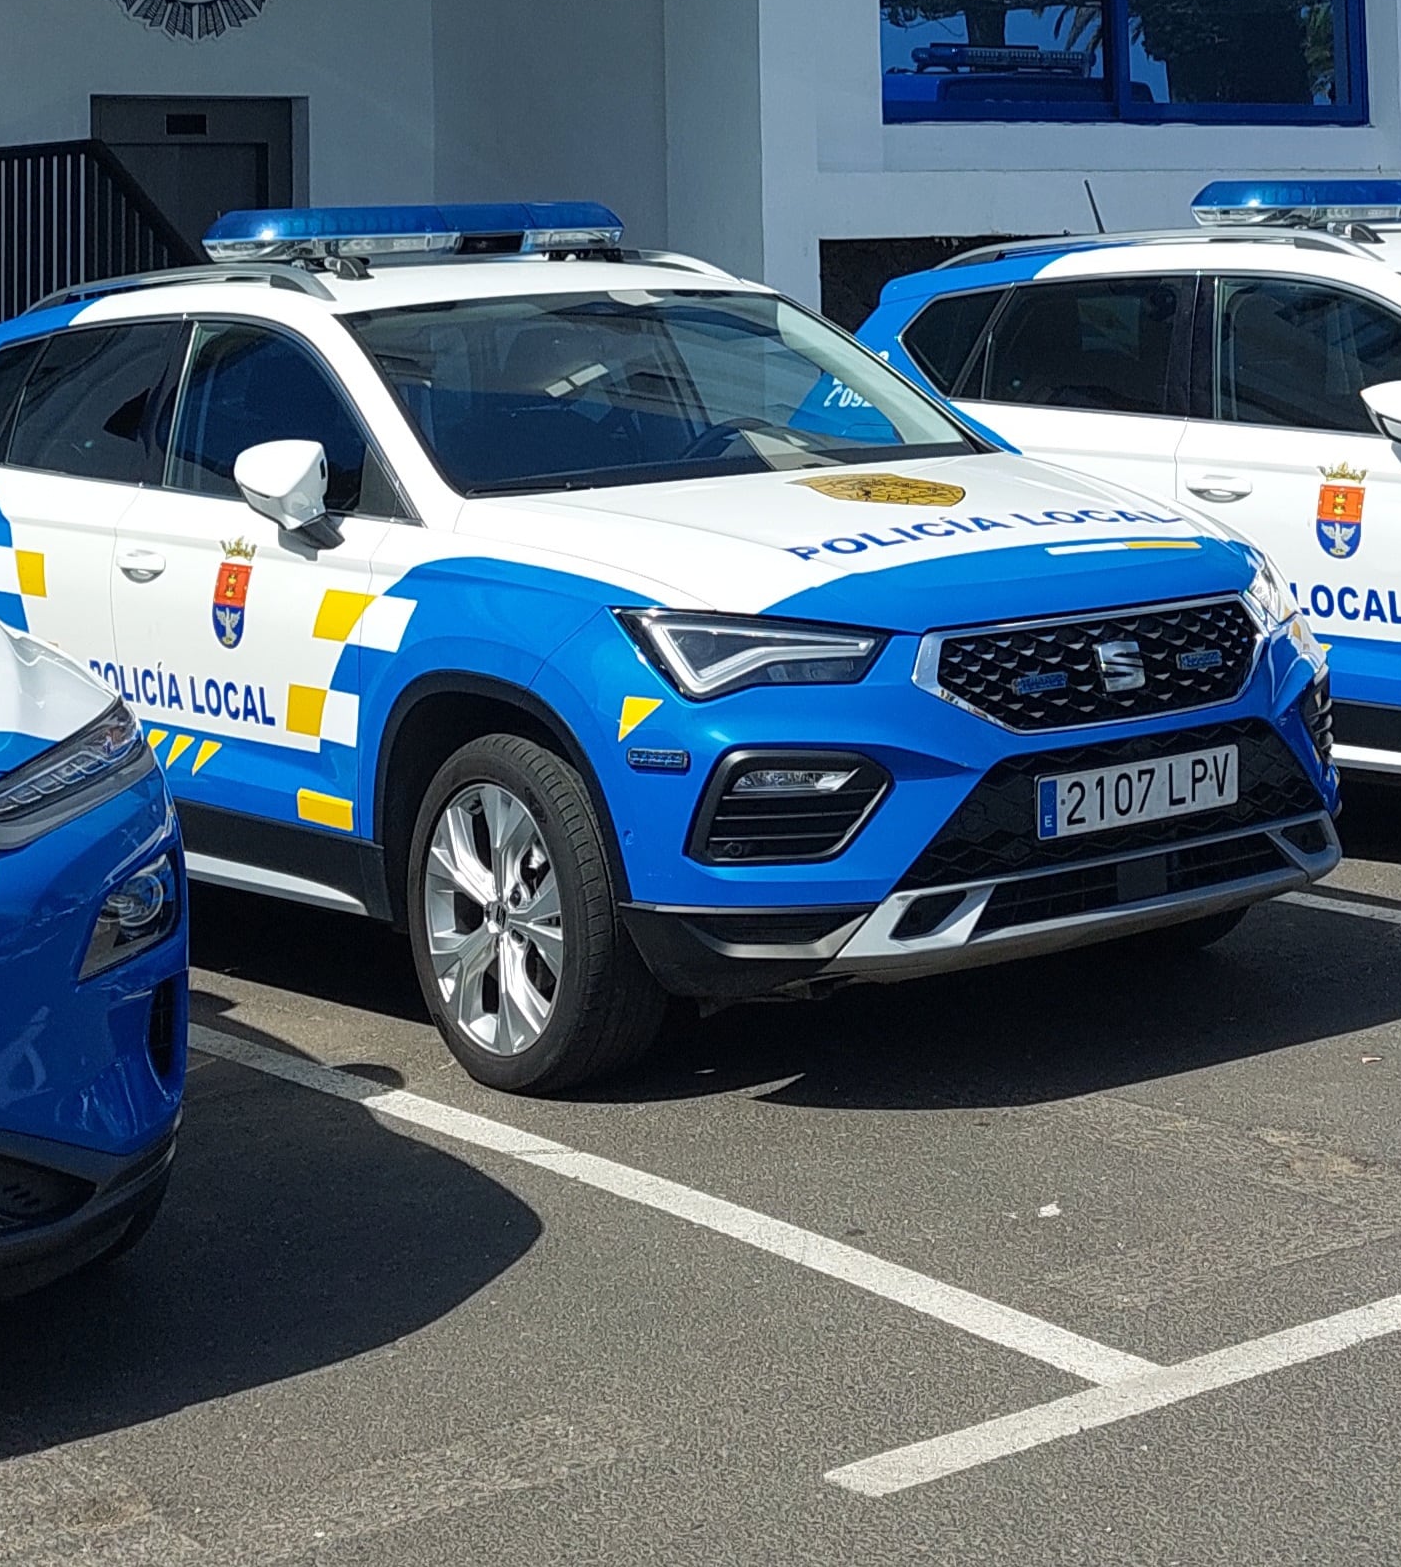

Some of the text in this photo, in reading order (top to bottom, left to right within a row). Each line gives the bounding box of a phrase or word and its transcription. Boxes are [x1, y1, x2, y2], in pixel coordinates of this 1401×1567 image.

[1009, 509, 1184, 526] LOCAL
[189, 676, 276, 726] LOCAL
[1066, 753, 1231, 827] 2107 LPV
